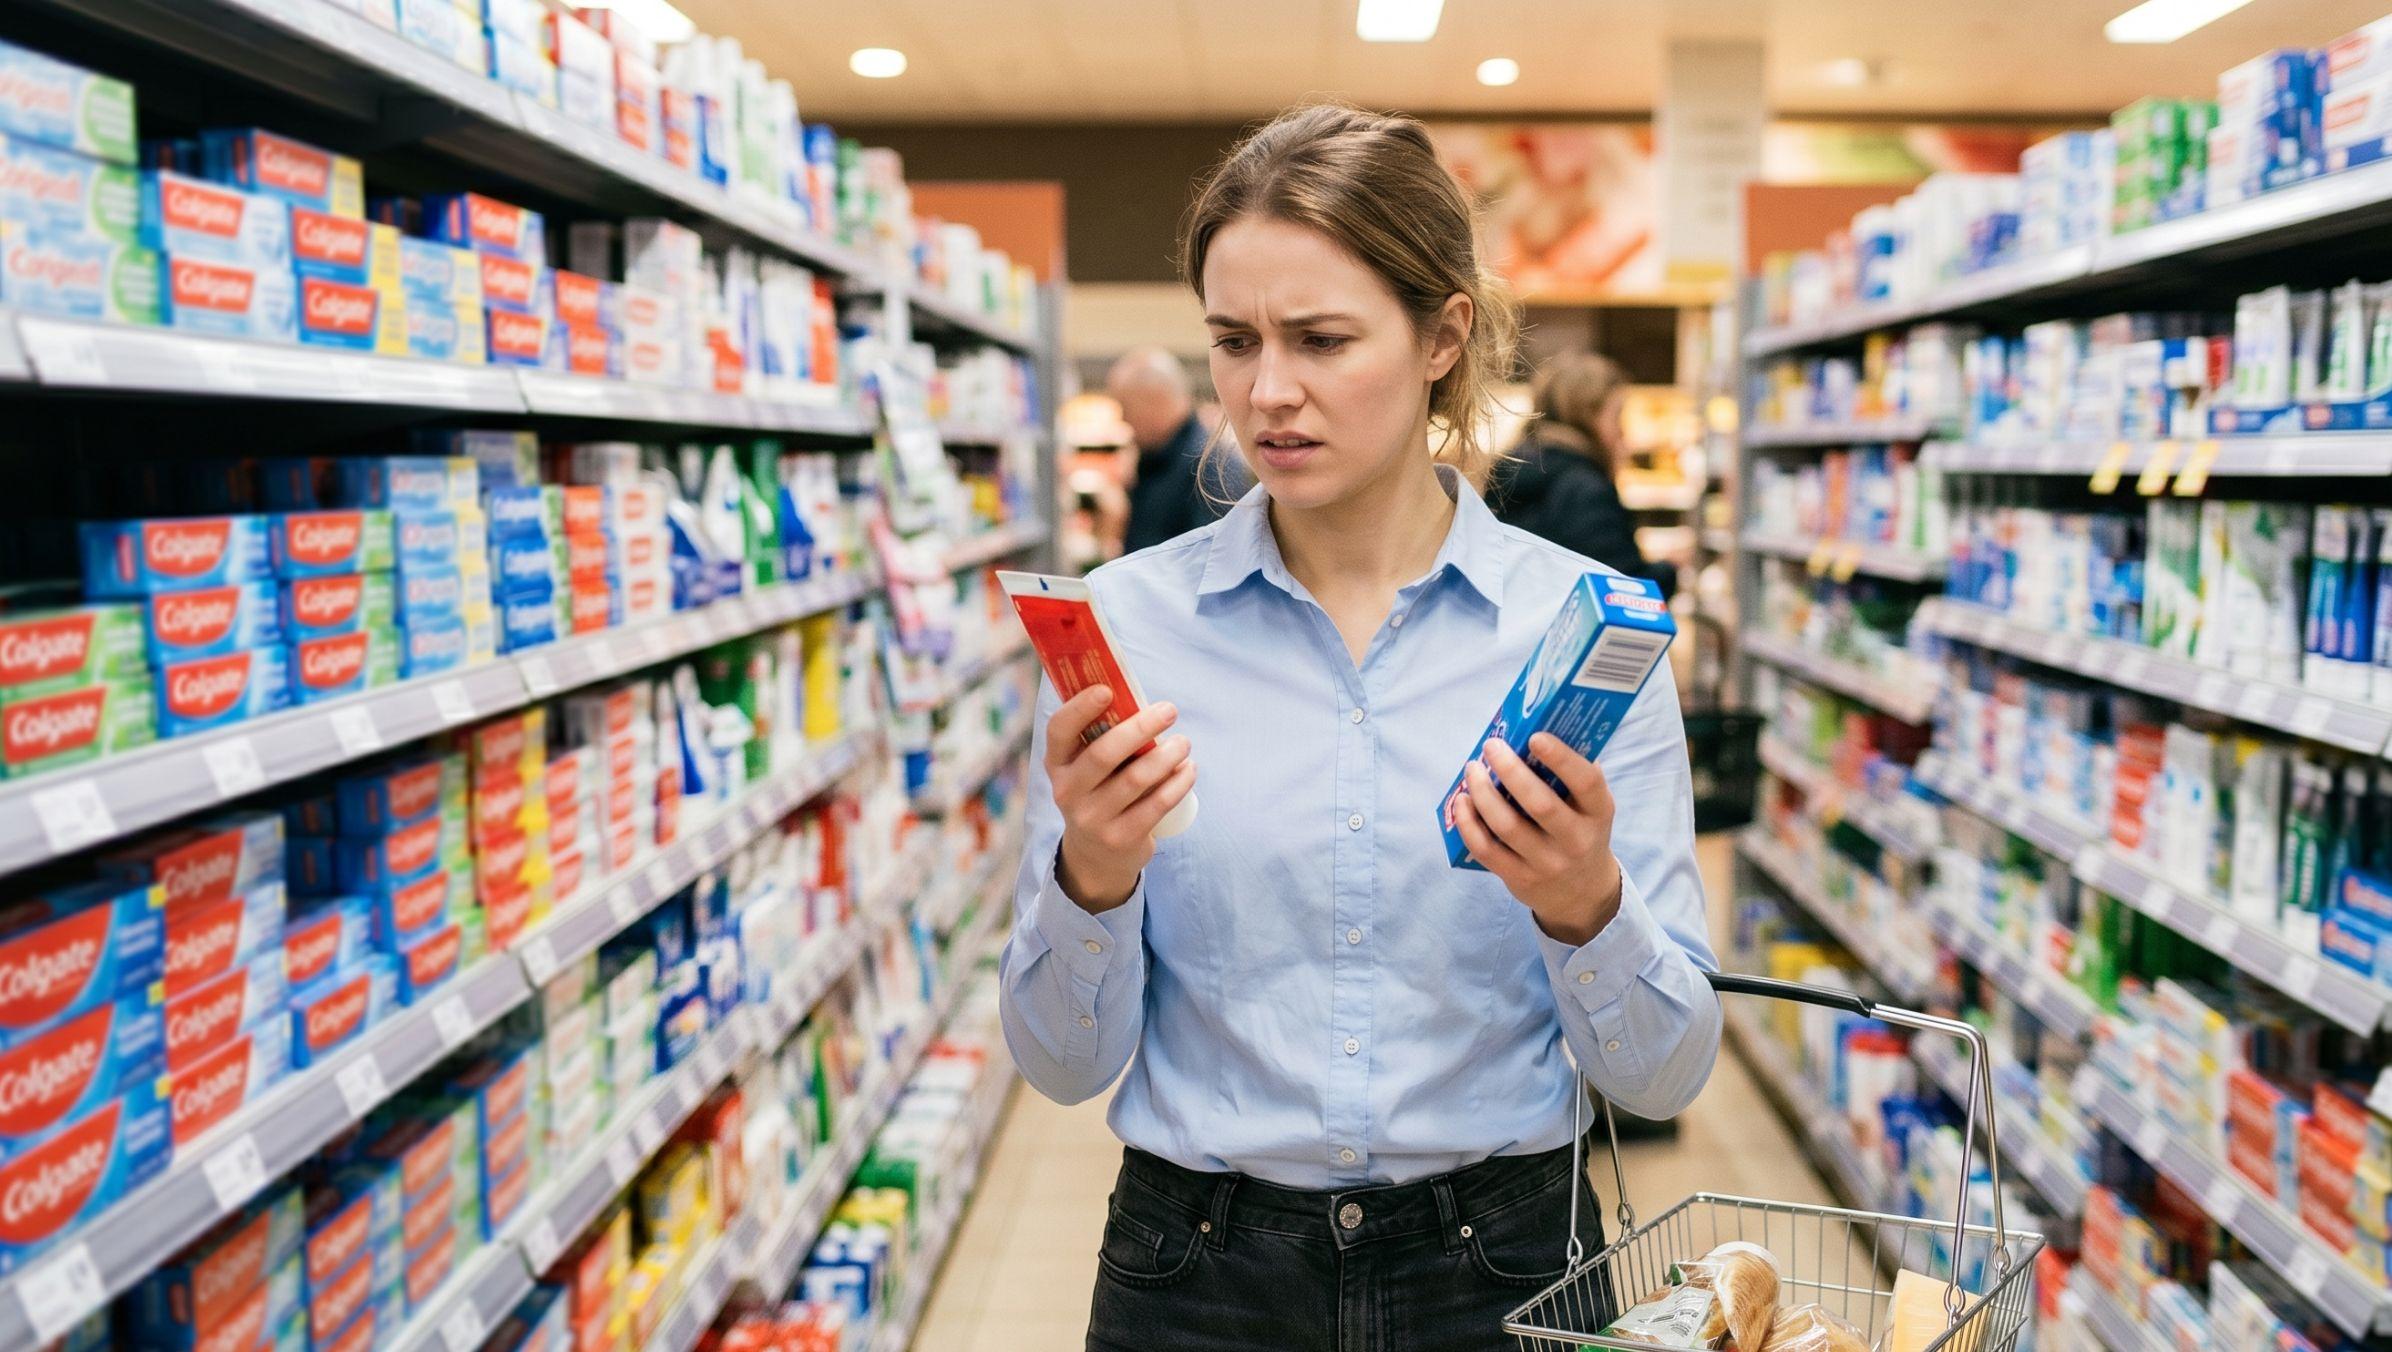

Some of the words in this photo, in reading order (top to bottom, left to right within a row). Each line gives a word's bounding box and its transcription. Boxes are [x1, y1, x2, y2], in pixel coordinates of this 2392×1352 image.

[169, 184, 238, 228] Colgate
[177, 265, 249, 306] Colgate
[151, 531, 223, 567] Colgate
[294, 522, 356, 555] Colgate
[159, 602, 232, 636] Colgate
[297, 586, 358, 618] Colgate
[0, 630, 85, 670] Colgate
[304, 645, 364, 678] Colgate
[173, 667, 242, 706] Colgate
[10, 703, 98, 745] Colgate
[168, 992, 239, 1047] Colgate
[0, 1040, 96, 1114] Colgate
[173, 1061, 244, 1122] Colgate
[2, 1142, 103, 1223] Colgate
